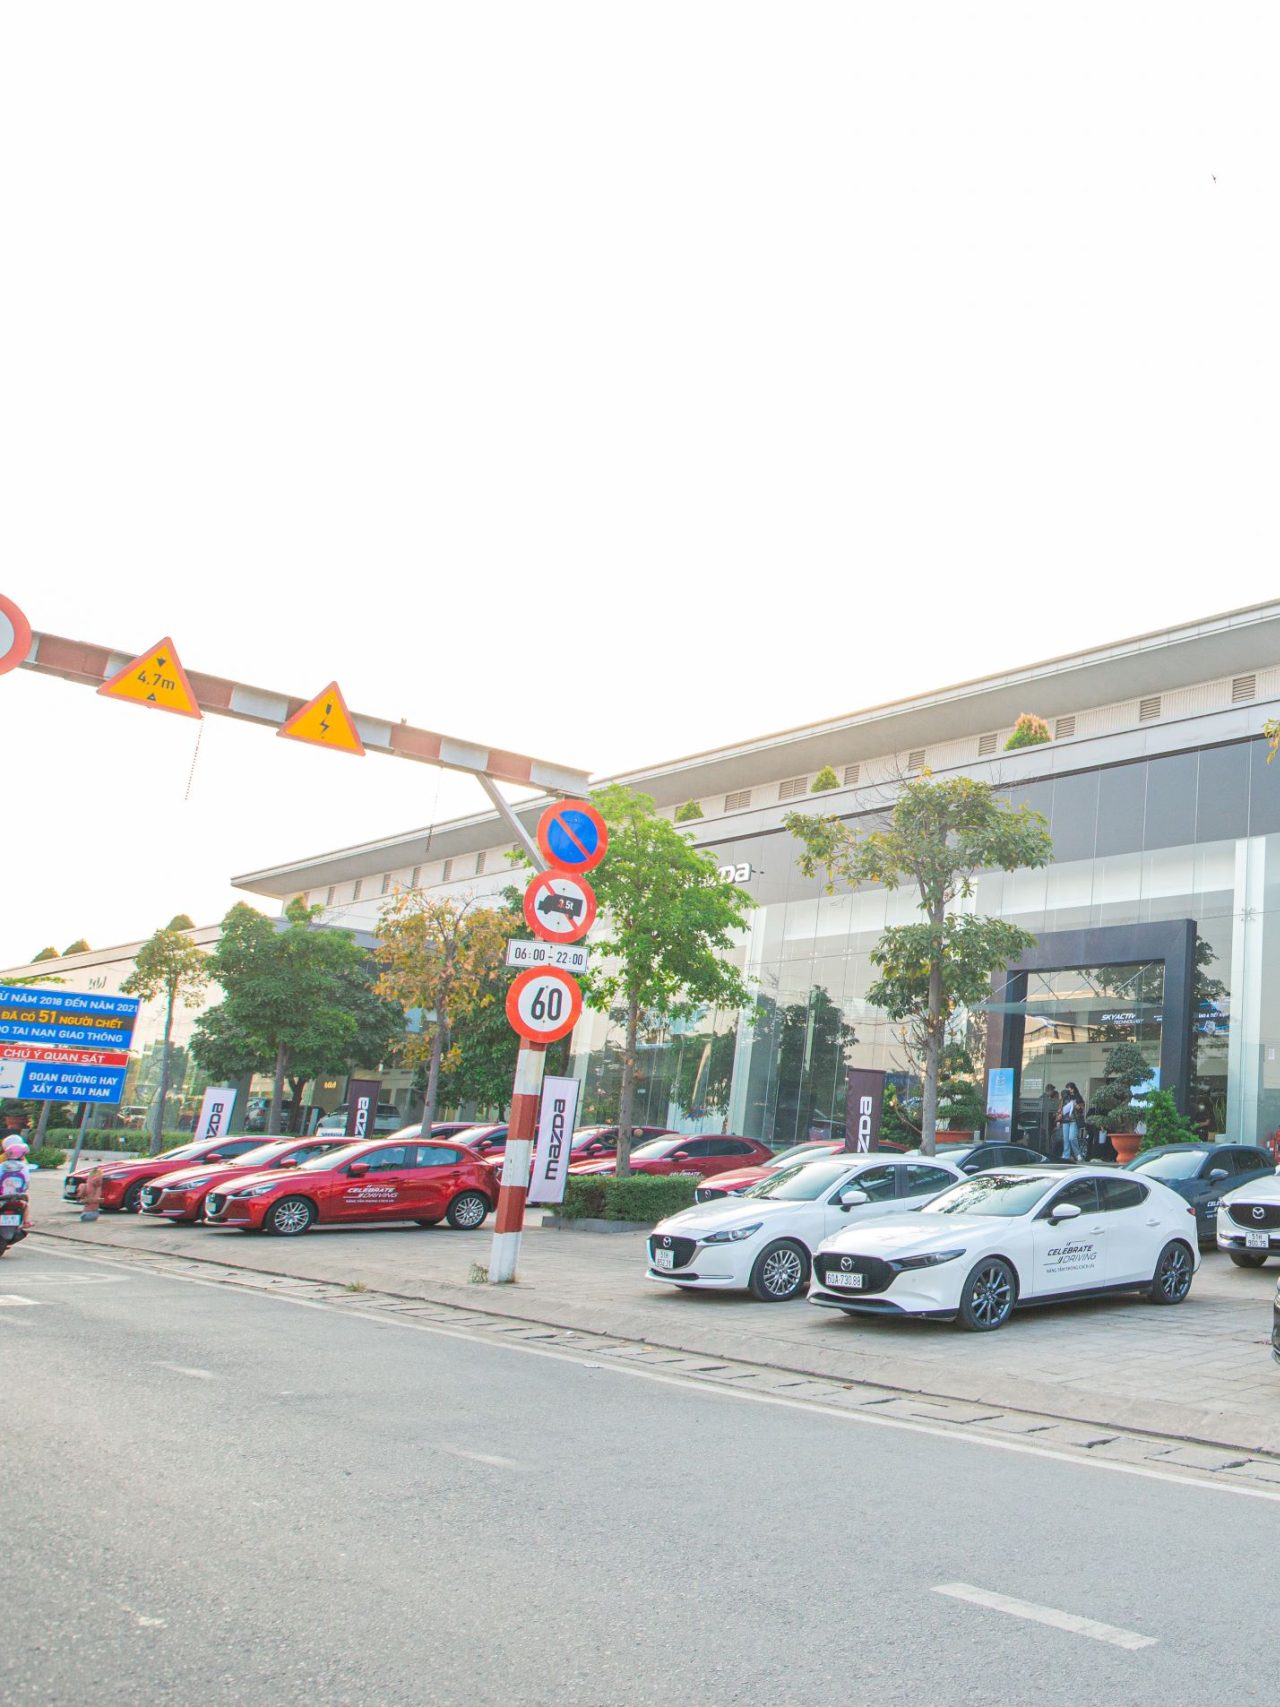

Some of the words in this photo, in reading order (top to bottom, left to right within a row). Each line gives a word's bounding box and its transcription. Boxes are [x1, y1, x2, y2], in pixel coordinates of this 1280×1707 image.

[137, 670, 175, 690] 4.7m
[514, 947, 546, 961] 06:00
[556, 951, 584, 966] 22:00
[39, 996, 62, 1006] 2018
[116, 1003, 138, 1012] 2021
[530, 986, 563, 1021] 60
[39, 1009, 57, 1024] 51
[12, 1026, 29, 1036] TAI
[58, 1030, 85, 1040] GIAO
[44, 1051, 79, 1062] QUAN
[80, 1053, 106, 1064] SÁT
[99, 1076, 119, 1086] HAY
[54, 1085, 68, 1095] RA
[857, 1096, 873, 1153] zda
[1047, 1244, 1094, 1256] CELEBRATE
